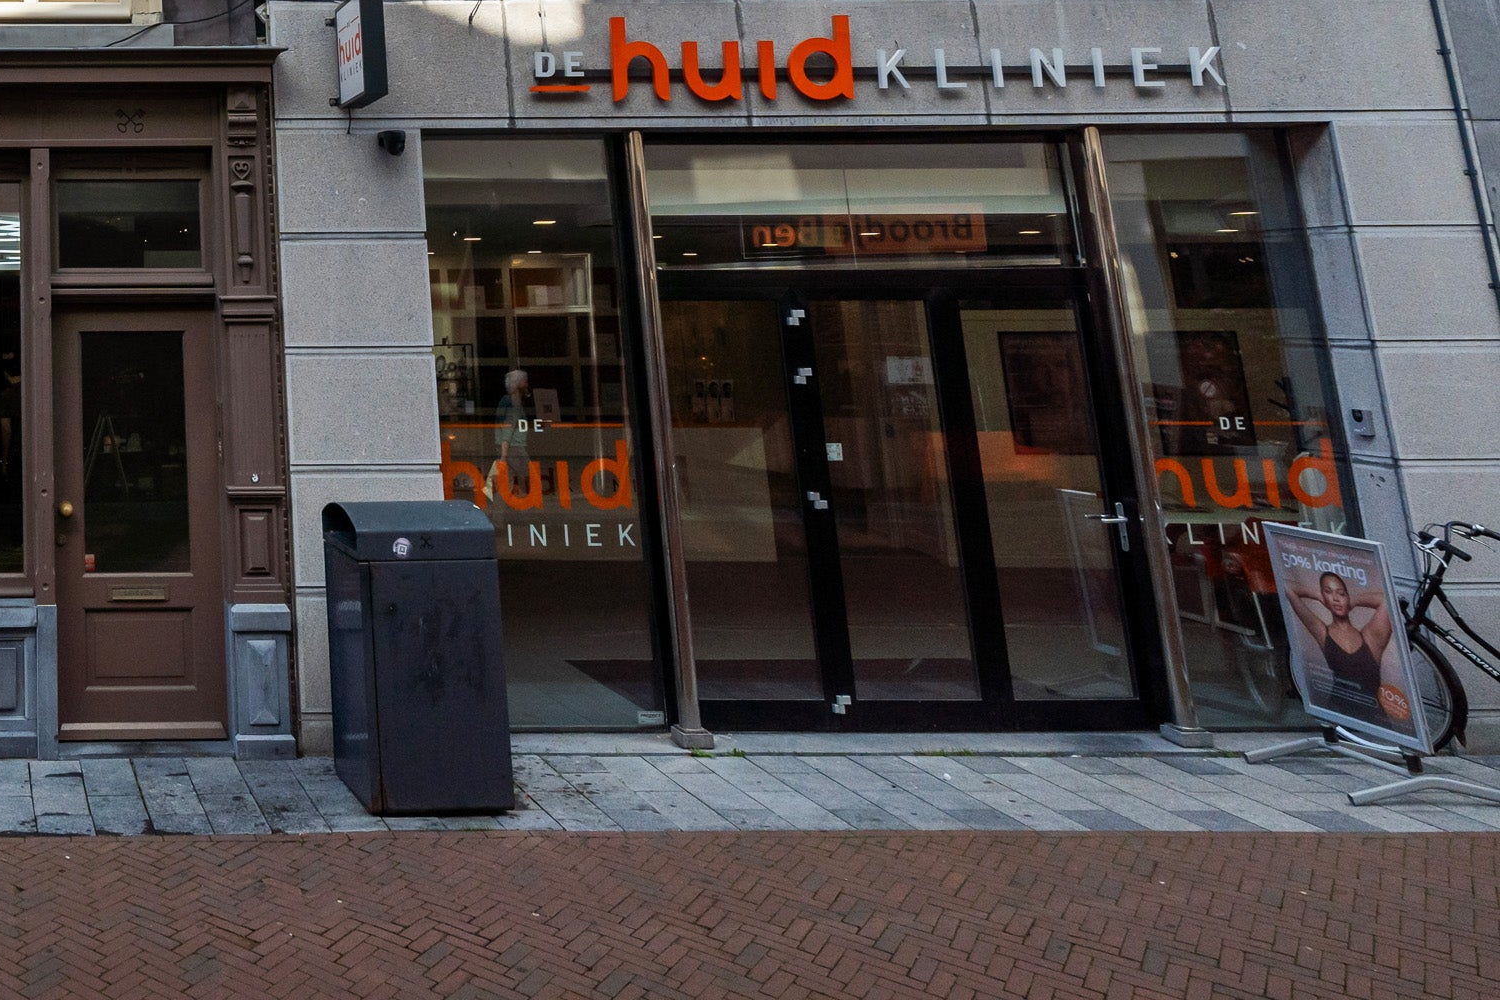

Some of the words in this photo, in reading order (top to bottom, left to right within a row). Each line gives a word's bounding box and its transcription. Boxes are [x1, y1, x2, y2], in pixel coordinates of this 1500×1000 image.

[338, 23, 362, 66] huid
[533, 51, 585, 78] DE
[608, 14, 855, 103] huid
[876, 46, 1228, 91] KLINIEK
[517, 418, 545, 434] DE
[1218, 416, 1247, 431] DE
[440, 438, 633, 511] huid
[506, 523, 637, 548] INIEK
[1281, 552, 1312, 569] 50%
[1312, 553, 1368, 588] korting
[1379, 687, 1408, 710] 10%
